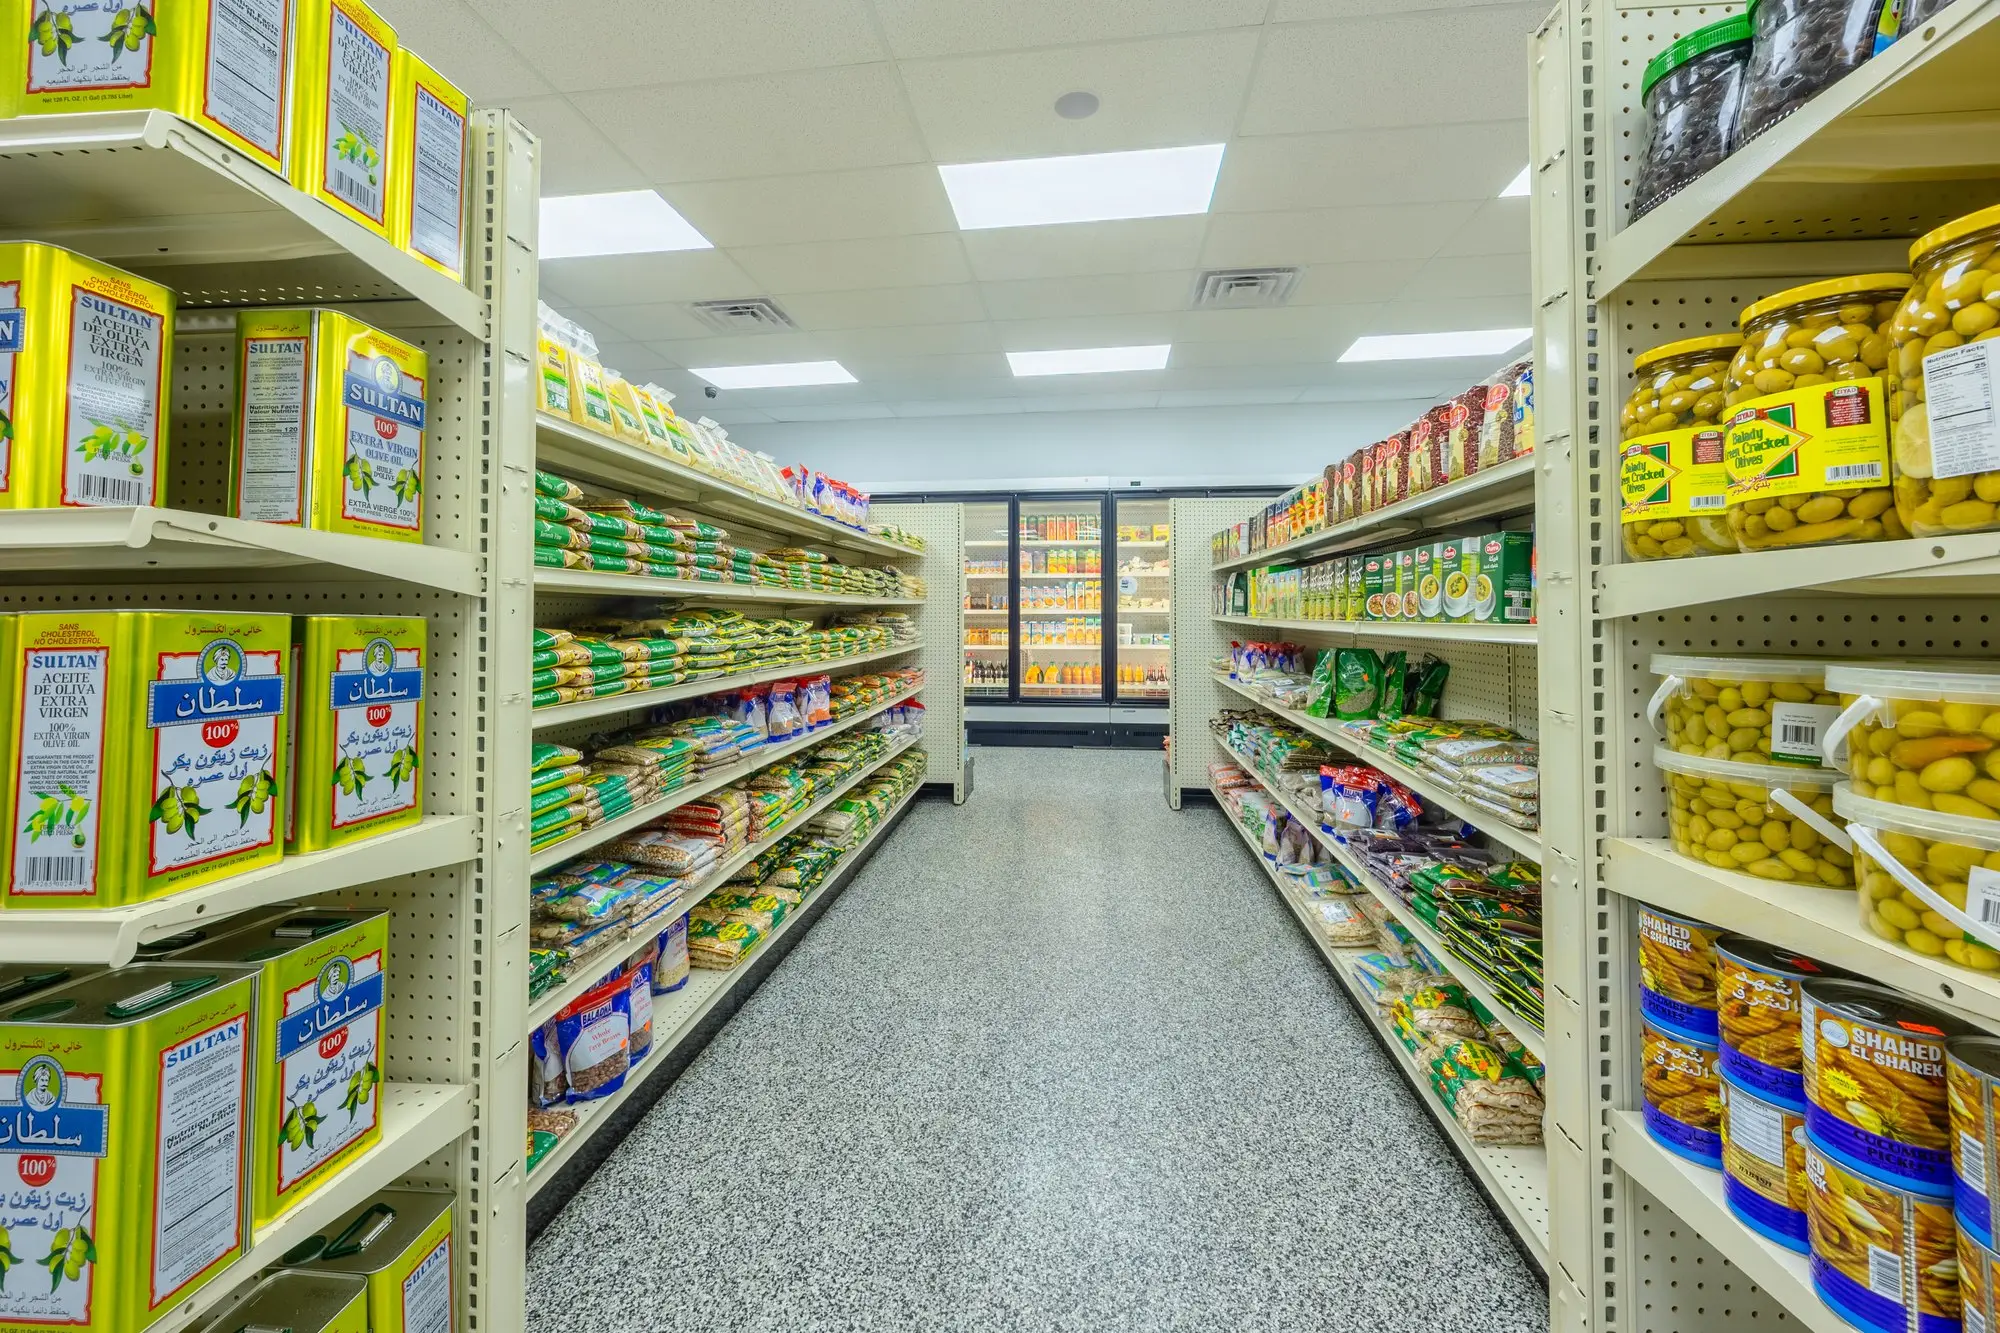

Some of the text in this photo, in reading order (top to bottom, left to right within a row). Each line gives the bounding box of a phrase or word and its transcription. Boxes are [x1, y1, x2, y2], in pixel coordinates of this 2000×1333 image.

[336, 13, 383, 60] SULTAN
[261, 43, 277, 57] 120
[338, 36, 382, 79] DE OLIVA
[344, 34, 378, 64] ACEITE
[342, 57, 377, 92] VIRGEN
[343, 50, 377, 83] EXTRA
[419, 90, 460, 127] SULTAN
[90, 276, 149, 302] CHOLESTEROL
[110, 276, 132, 290] SANS
[82, 280, 155, 310] NO CHOLESTEROL
[81, 296, 152, 329] SULTAN
[83, 321, 150, 351] DE OLIVA
[91, 315, 144, 339] ACEITE
[90, 334, 141, 358] EXTRA
[90, 343, 144, 368] VIRGEN
[250, 342, 302, 354] SULTAN
[1926, 345, 1985, 364] Nutrition Facts
[101, 361, 131, 376] 100%
[1974, 361, 1987, 369] 25
[84, 364, 146, 386] EXTRA VIRGIN
[94, 375, 134, 390] OLIVE OIL
[1928, 371, 1953, 382] Calories
[1837, 387, 1857, 395] ZIYAD
[349, 383, 421, 422] SULTAN
[1736, 410, 1754, 421] ZIYAD
[375, 419, 398, 434] 100%
[350, 430, 418, 458] EXTRA VIRGIN
[1732, 428, 1763, 446] Balady
[1742, 435, 1789, 455] Cracked
[365, 448, 403, 466] OLIVE OIL
[1735, 454, 1763, 469] Olives
[373, 470, 395, 481] D'OLIVE
[376, 465, 393, 474] HUILE
[1626, 461, 1646, 473] Balady
[1631, 469, 1665, 482] Cracked
[1626, 483, 1646, 495] Olives
[1753, 481, 1771, 492] بلدي
[348, 499, 416, 518] EXTRA VIERGE 100%
[41, 630, 95, 638] CHOLESTEROL
[47, 637, 101, 645] CHOLESTEROL
[229, 627, 241, 636] من
[243, 626, 262, 637] خالي
[32, 655, 98, 668] SULTAN
[42, 672, 90, 684] ACEITE
[34, 683, 95, 695] DE OLIVA
[349, 677, 409, 702] سلطان
[40, 696, 87, 707] EXTRA
[176, 686, 263, 718] سلطان
[39, 707, 88, 718] VIRGEN
[369, 706, 391, 721] 100%
[34, 732, 90, 740] EXTRA VIRGIN
[49, 723, 76, 732] 100%
[205, 722, 239, 741] 100%
[343, 724, 412, 748] زيت زيتون بكر
[43, 739, 80, 748] OLIVE OIL
[357, 746, 382, 759] عصره
[166, 743, 268, 774] زيت زيتون بكر
[187, 771, 224, 788] عصره
[1642, 913, 1691, 940] SHAHED
[1642, 927, 1692, 951] EL SHAREK
[1735, 971, 1793, 995] شهد
[1733, 984, 1799, 1013] الشرق
[298, 995, 368, 1042] سلطان
[582, 1002, 612, 1027] BALADNA
[1649, 1000, 1686, 1021] PICKLES
[321, 1029, 347, 1054] 100%
[592, 1027, 611, 1041] Whole
[602, 1032, 621, 1047] Beans
[48, 1041, 60, 1052] من
[63, 1041, 82, 1054] خالي
[166, 1021, 242, 1068] SULTAN
[1656, 1040, 1704, 1063] شهد
[1852, 1027, 1942, 1062] SHAHED
[290, 1038, 371, 1099] زيت زيتون بكر
[1653, 1051, 1709, 1078] الشرق
[1730, 1053, 1803, 1088] مخلل يار
[1851, 1046, 1945, 1078] EL SHAREK
[0, 1111, 82, 1147] سلطان
[166, 1118, 209, 1145] Nutrition
[211, 1102, 237, 1118] Facts
[166, 1107, 236, 1150] Valeur Nutritive
[1652, 1113, 1679, 1132] مخلل
[217, 1130, 235, 1145] 120
[1853, 1129, 1950, 1164] CUCUMBER
[21, 1158, 56, 1176] 100%
[1867, 1143, 1936, 1174] PICKLES
[9, 1190, 86, 1212] زيت زيتون
[0, 1216, 38, 1230] عصره
[406, 1243, 446, 1292] SULTAN
